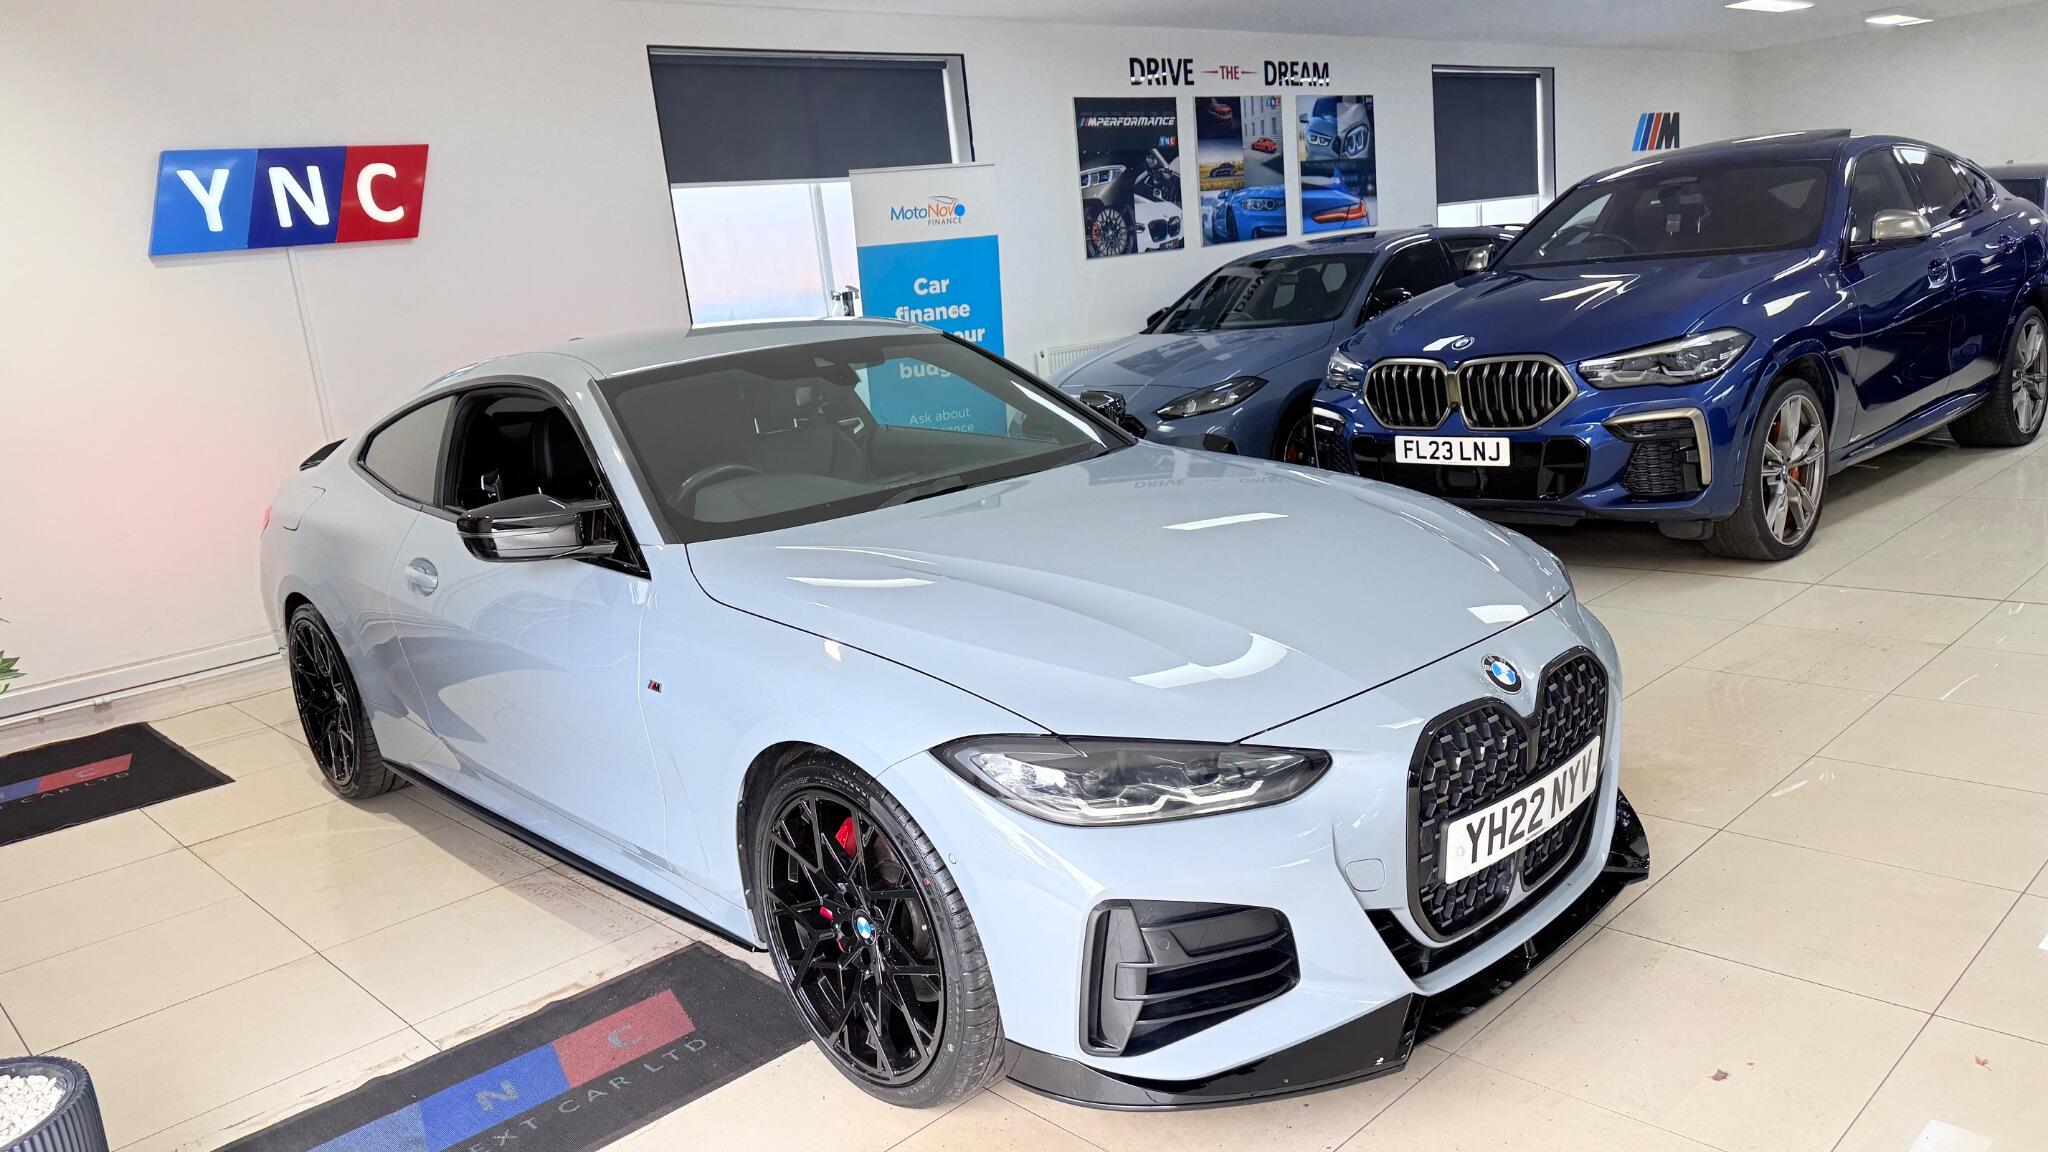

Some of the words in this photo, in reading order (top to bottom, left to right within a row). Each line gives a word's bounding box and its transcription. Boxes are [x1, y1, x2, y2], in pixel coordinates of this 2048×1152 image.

[1129, 57, 1195, 86] DRIVE
[1219, 65, 1240, 80] THE
[1263, 60, 1330, 87] DREAM
[175, 162, 405, 232] YNC
[890, 201, 966, 221] MotoNovo
[927, 217, 962, 226] FINANCE
[913, 277, 950, 295] Car
[895, 303, 971, 323] finance
[909, 412, 932, 425] Ask
[935, 407, 971, 422] about
[1403, 439, 1453, 460] FL23
[1459, 441, 1500, 461] LNJ
[1466, 787, 1546, 864] YH22
[1550, 748, 1594, 819] NYV
[558, 1075, 632, 1114] CAR
[643, 1039, 708, 1073] LTD
